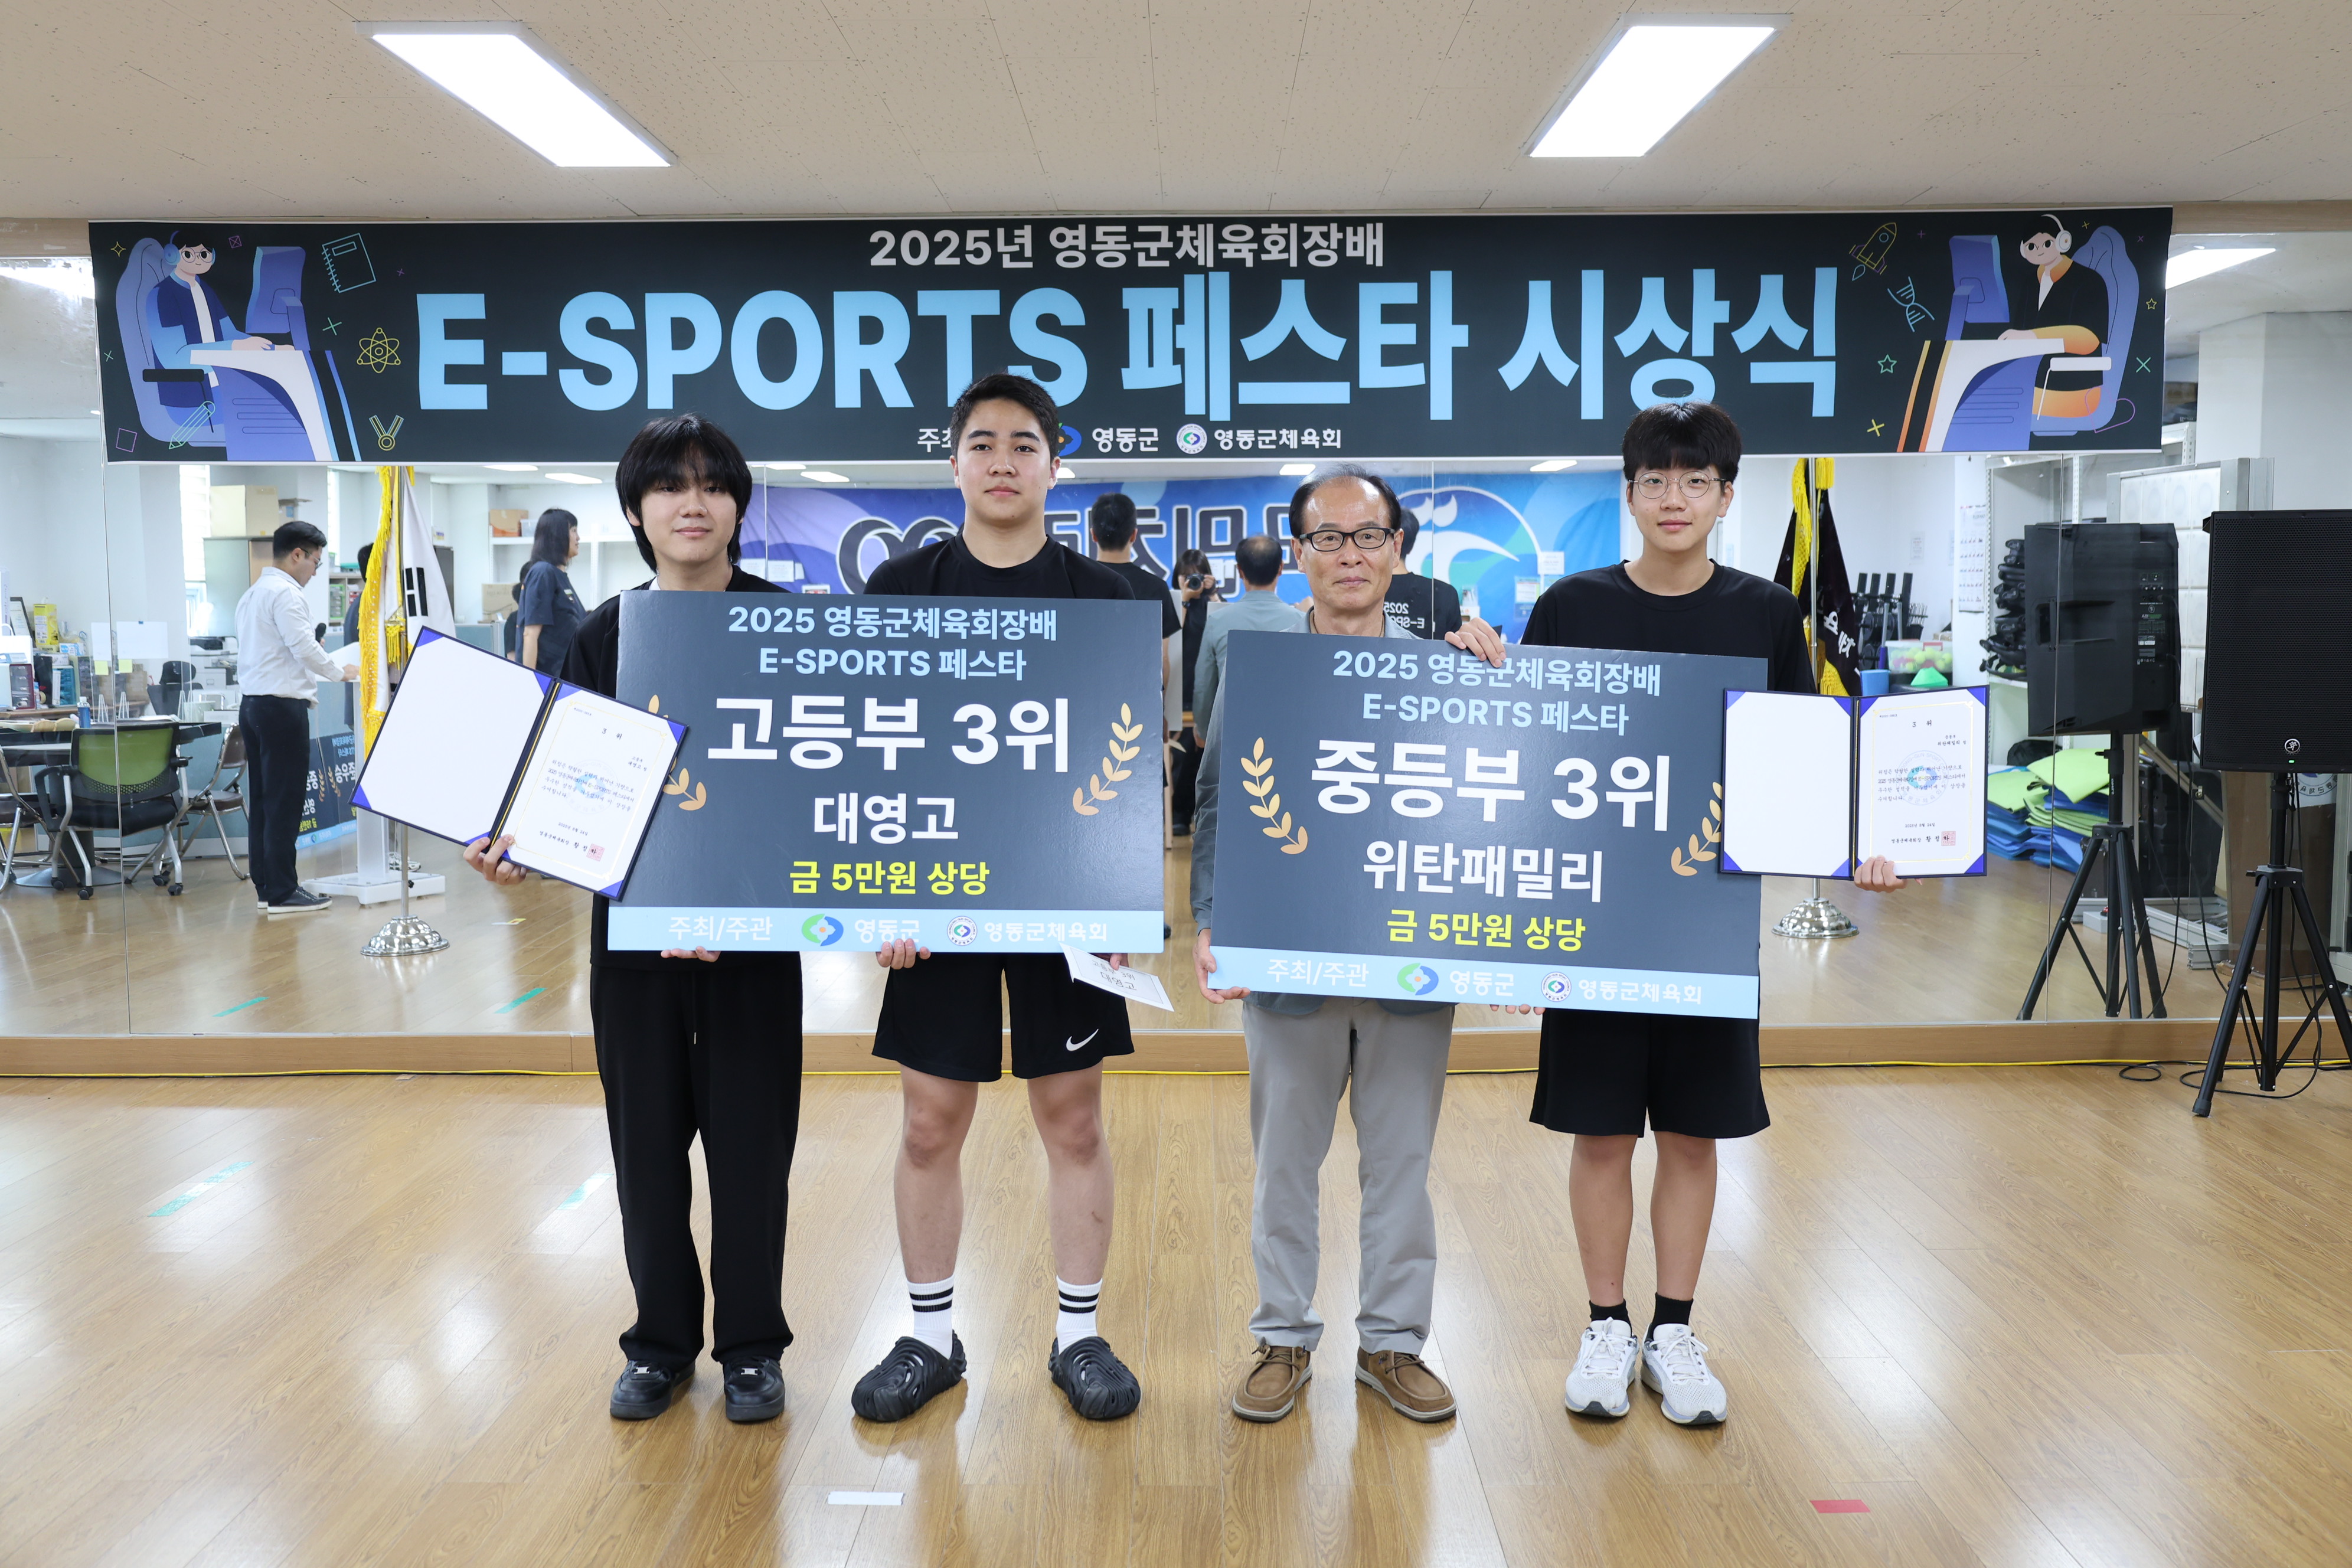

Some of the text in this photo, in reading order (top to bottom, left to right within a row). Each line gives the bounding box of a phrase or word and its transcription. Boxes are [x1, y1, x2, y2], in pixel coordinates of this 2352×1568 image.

[870, 223, 1383, 268] 2025년 영동군체육회장배
[416, 267, 1838, 422] E-SPORTS 페스타 시상식
[1092, 427, 1159, 453] 영동군
[1214, 428, 1342, 450] 영동군체육회
[729, 606, 1057, 641] 2025 영동군체육회장배
[759, 648, 1027, 681] E-SPORTS 페스타
[1333, 650, 1661, 697] 2025 영동군체육회장배
[707, 695, 1069, 773] 고등부 3위
[1363, 693, 1629, 736] E-SPORTS 페스타
[1310, 739, 1670, 832] 중등부 3위
[814, 792, 959, 845] 대영고
[790, 861, 990, 896] 금 5만원 상당
[1363, 839, 1603, 903] 위탄패밀리
[668, 916, 773, 941] 주최/주관
[854, 919, 920, 943] 영동군
[984, 922, 1108, 943] 영동군체육회
[1388, 910, 1586, 952] 금 5만원 상당
[1100, 972, 1137, 991] 대영고
[1267, 959, 1370, 988] 주최/주관
[1449, 970, 1514, 997] 영동군
[1578, 979, 1702, 1005] 영동군체육회
